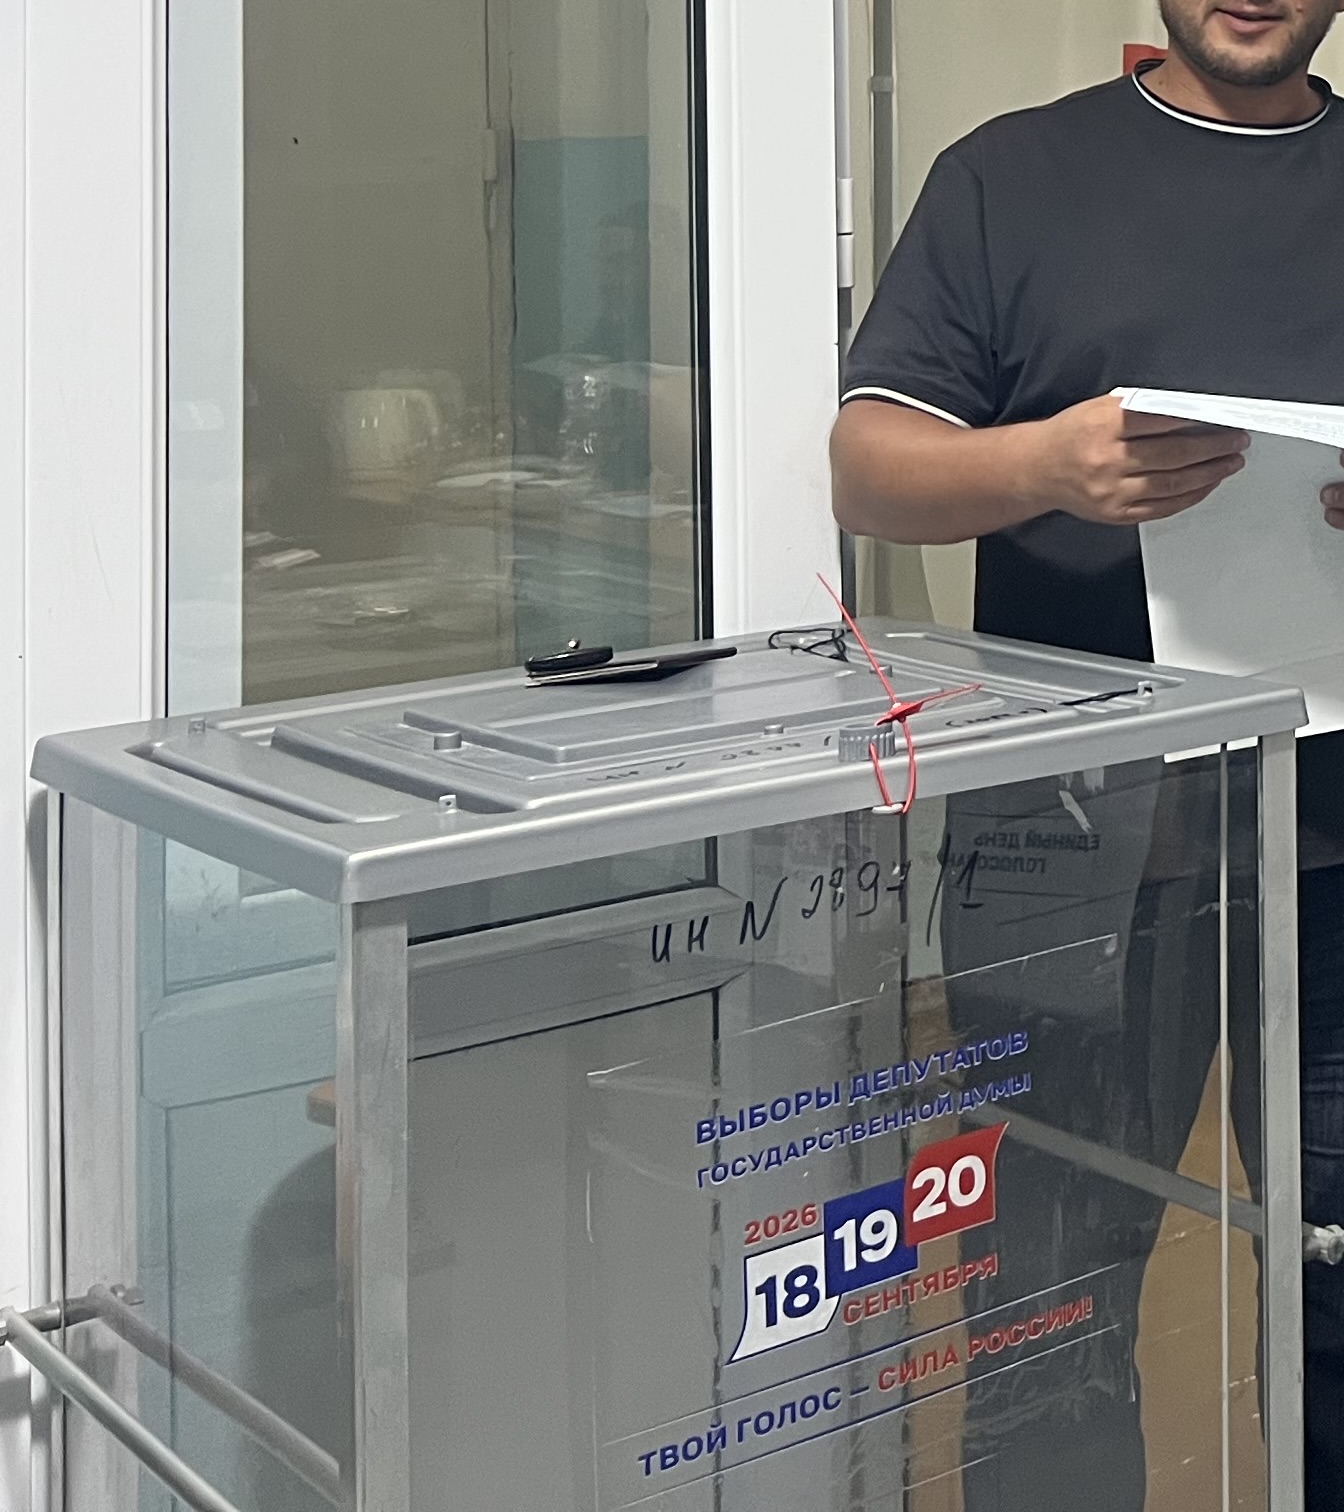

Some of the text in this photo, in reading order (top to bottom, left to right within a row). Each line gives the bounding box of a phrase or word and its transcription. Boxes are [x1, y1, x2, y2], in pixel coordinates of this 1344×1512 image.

[695, 1031, 1029, 1145] ВЫБОРЫ ДЕПУТАТОВ
[696, 1071, 1032, 1189] ГОСУДАРСТВЕННОЙ ДУМЫ
[744, 1204, 818, 1245] 2026
[755, 1154, 987, 1328] 18 19 20
[842, 1252, 998, 1326] СЕНТЯБРЯ
[637, 1423, 727, 1477] ТВОЙ
[737, 1387, 841, 1445] ГОЛОС
[878, 1345, 959, 1392] СИЛА
[966, 1295, 1095, 1362] РОССИИ!
